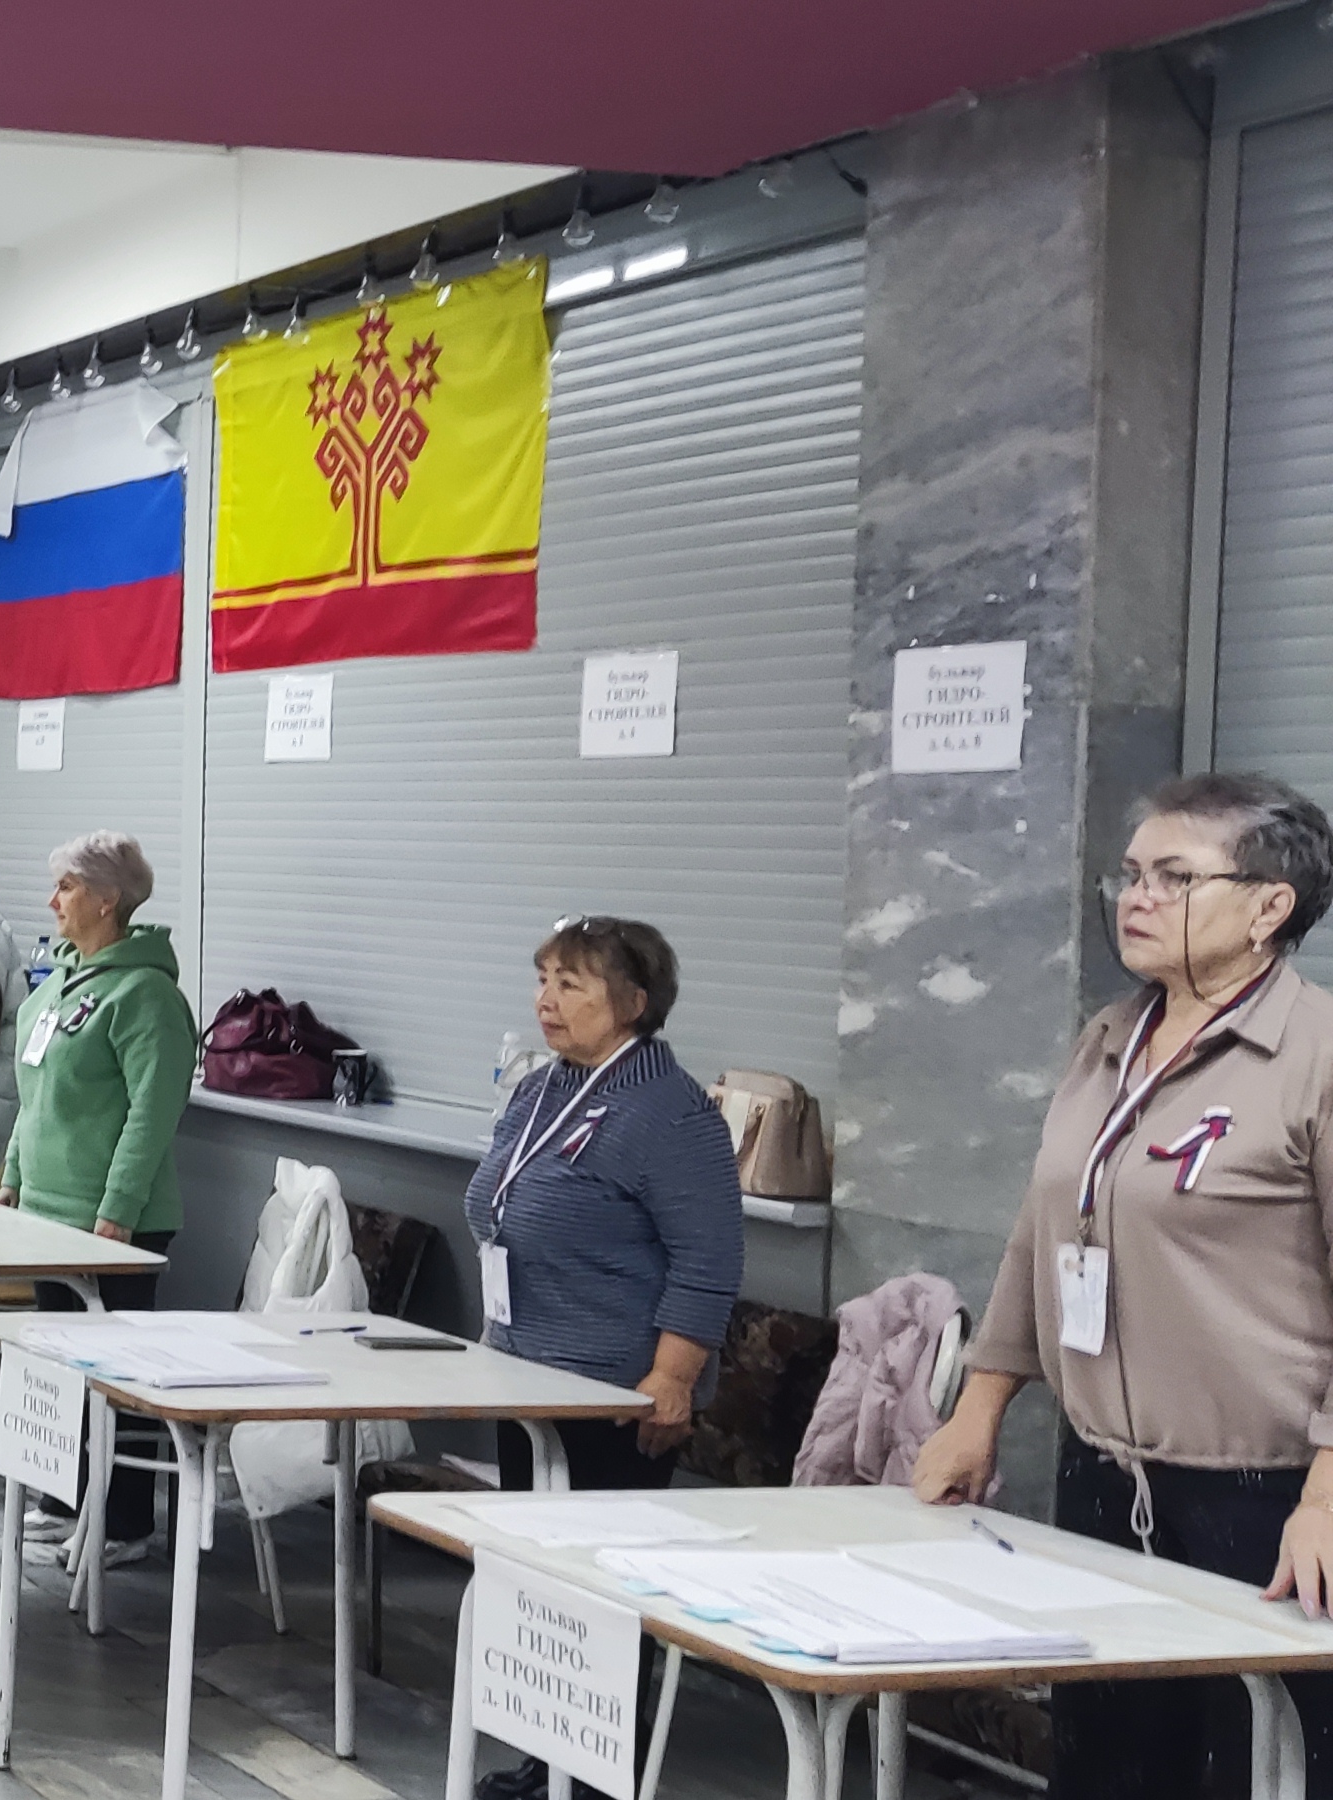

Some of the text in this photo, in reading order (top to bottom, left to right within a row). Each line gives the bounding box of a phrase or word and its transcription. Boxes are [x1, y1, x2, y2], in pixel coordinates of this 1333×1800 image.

[23, 1366, 60, 1401] бульвар
[23, 1392, 61, 1422] ГИДРО-
[3, 1411, 75, 1458] СТРОИТЕЛЕЙ
[517, 1590, 587, 1644] бульвар
[517, 1623, 591, 1673] ГИДРО-
[484, 1647, 622, 1728] СТРОИТЕЛЕЙ
[482, 1685, 623, 1765] д. 10, д. 18, СНТ
